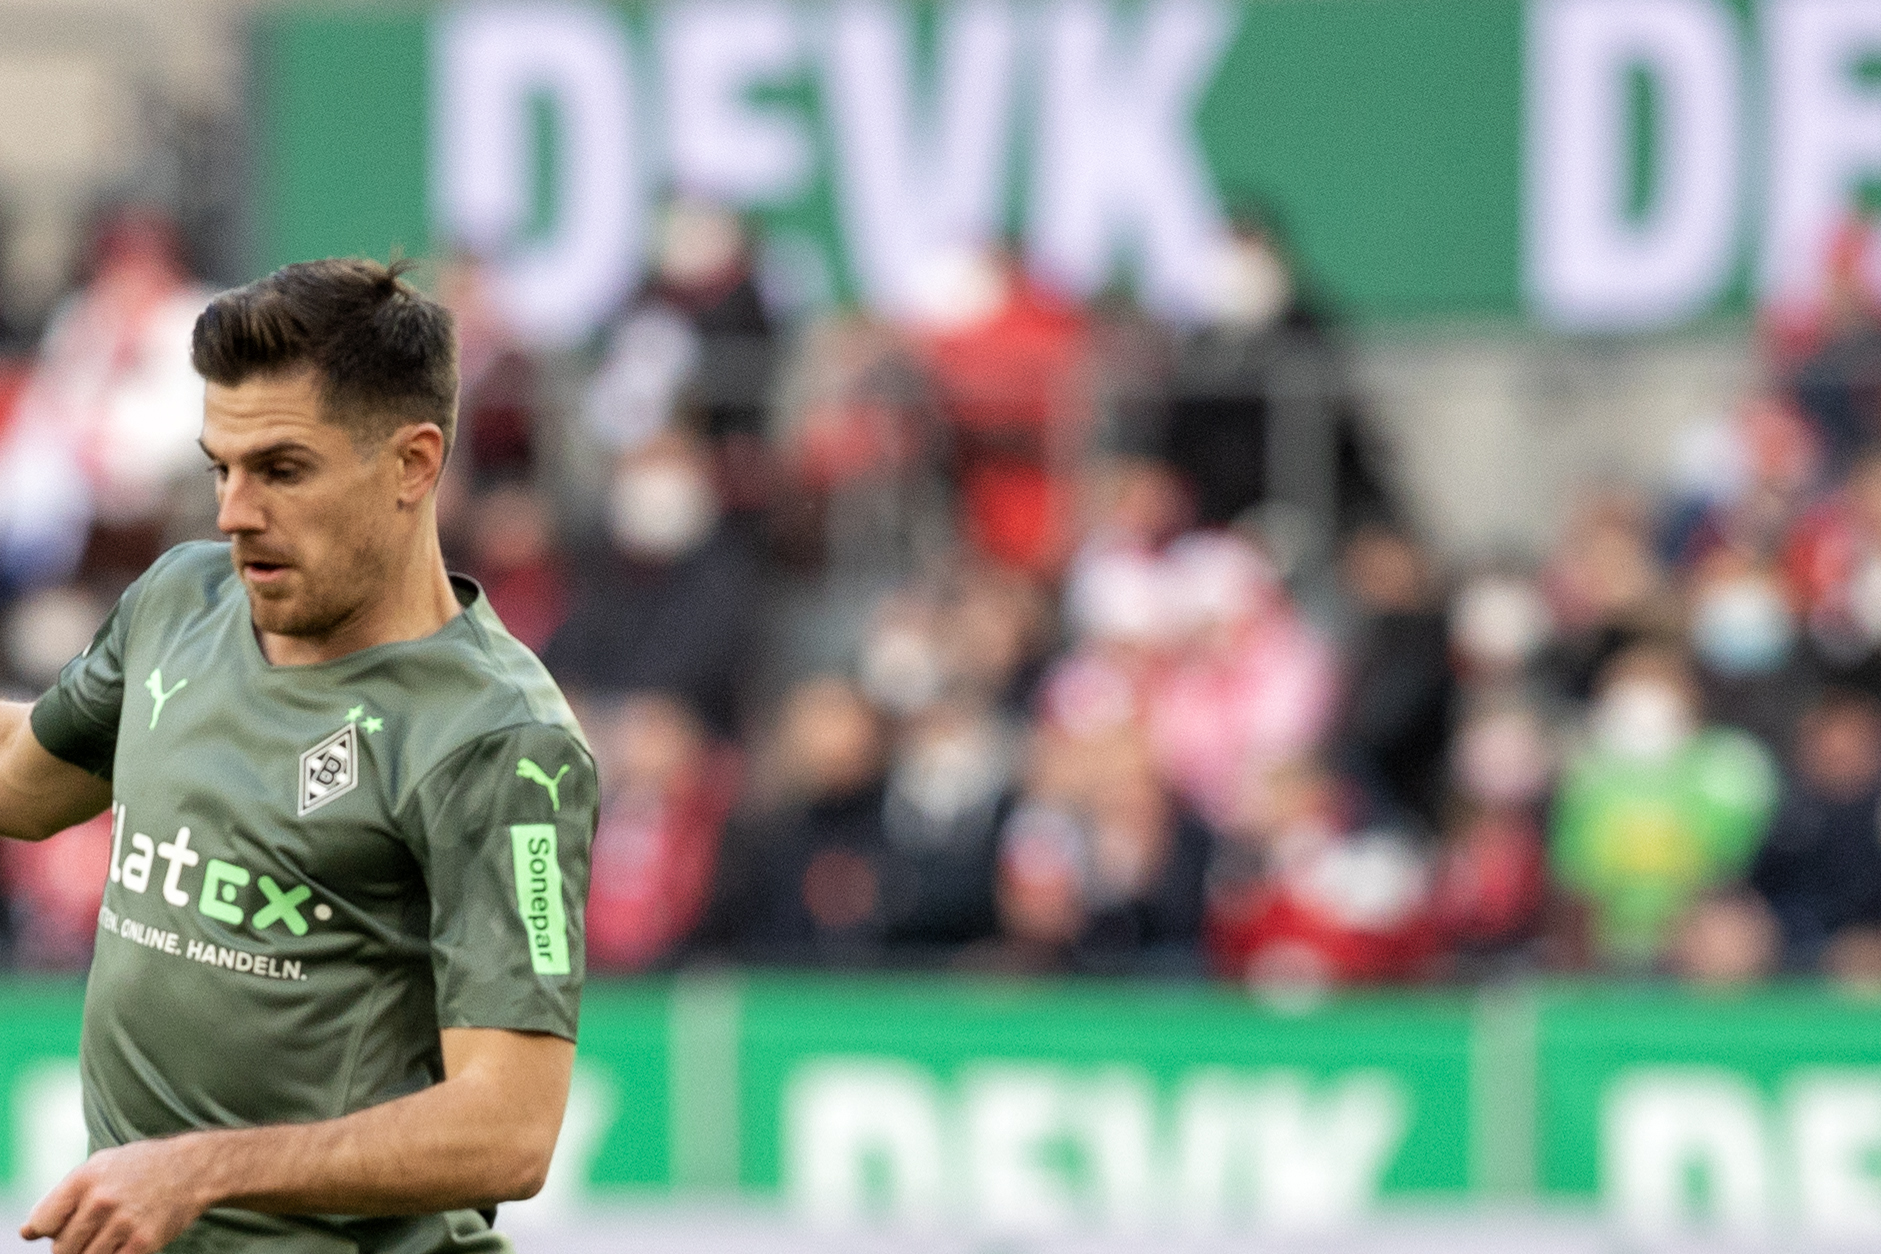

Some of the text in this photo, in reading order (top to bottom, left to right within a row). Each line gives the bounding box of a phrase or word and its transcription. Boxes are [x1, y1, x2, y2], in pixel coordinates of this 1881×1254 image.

[528, 837, 554, 962] Sonepar
[120, 918, 182, 956] ONLINE.
[185, 938, 308, 981] HANDELN.
